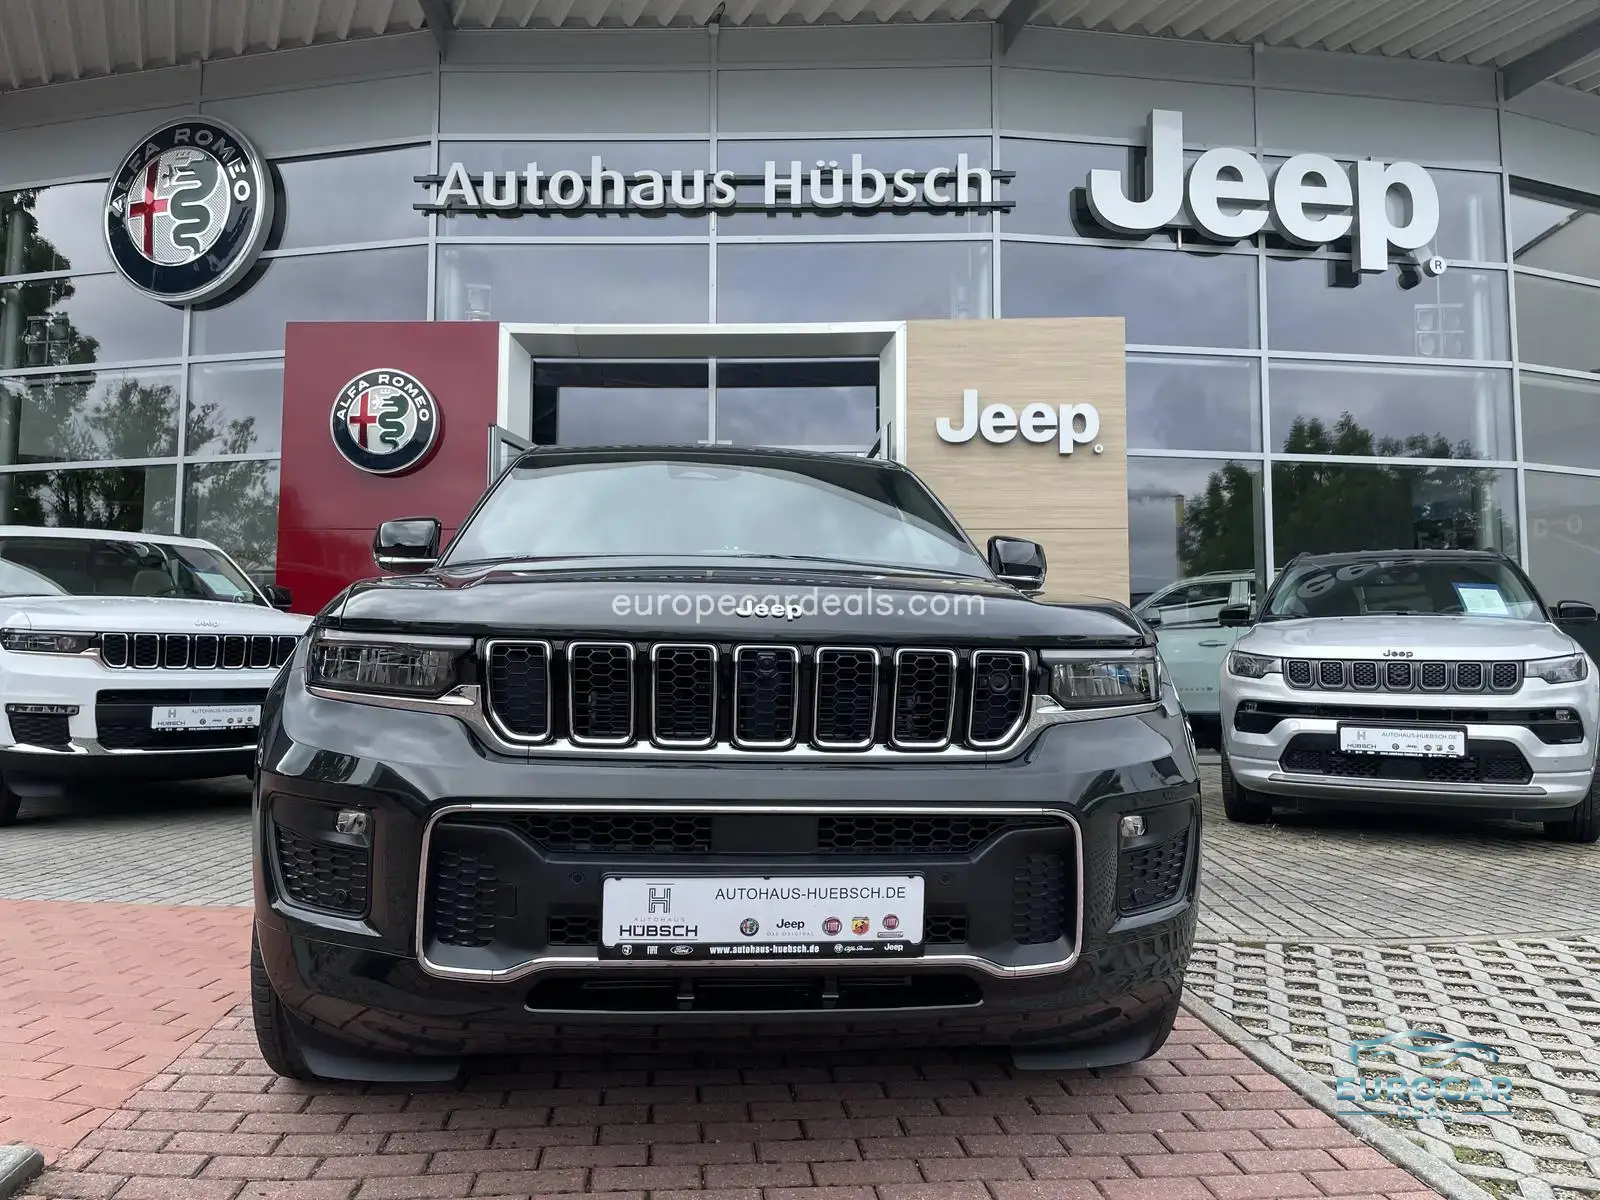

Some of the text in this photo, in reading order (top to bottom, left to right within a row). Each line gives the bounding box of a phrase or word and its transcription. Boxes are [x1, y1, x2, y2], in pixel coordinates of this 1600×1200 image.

[110, 127, 251, 214] ALFA ROMEO
[435, 152, 992, 208] Autohaus Hübsch
[1087, 109, 1440, 274] Jeep
[336, 374, 430, 422] ALFA ROMEO
[935, 389, 1100, 454] Jeep
[735, 599, 803, 622] Jeep
[714, 886, 906, 900] AUTOHAUS-HUEBSCH.DE
[619, 924, 698, 937] HÜBSCH
[776, 918, 805, 930] Jeep
[709, 944, 820, 955] www.autohaus-huebsch.de
[883, 942, 904, 952] Jeep
